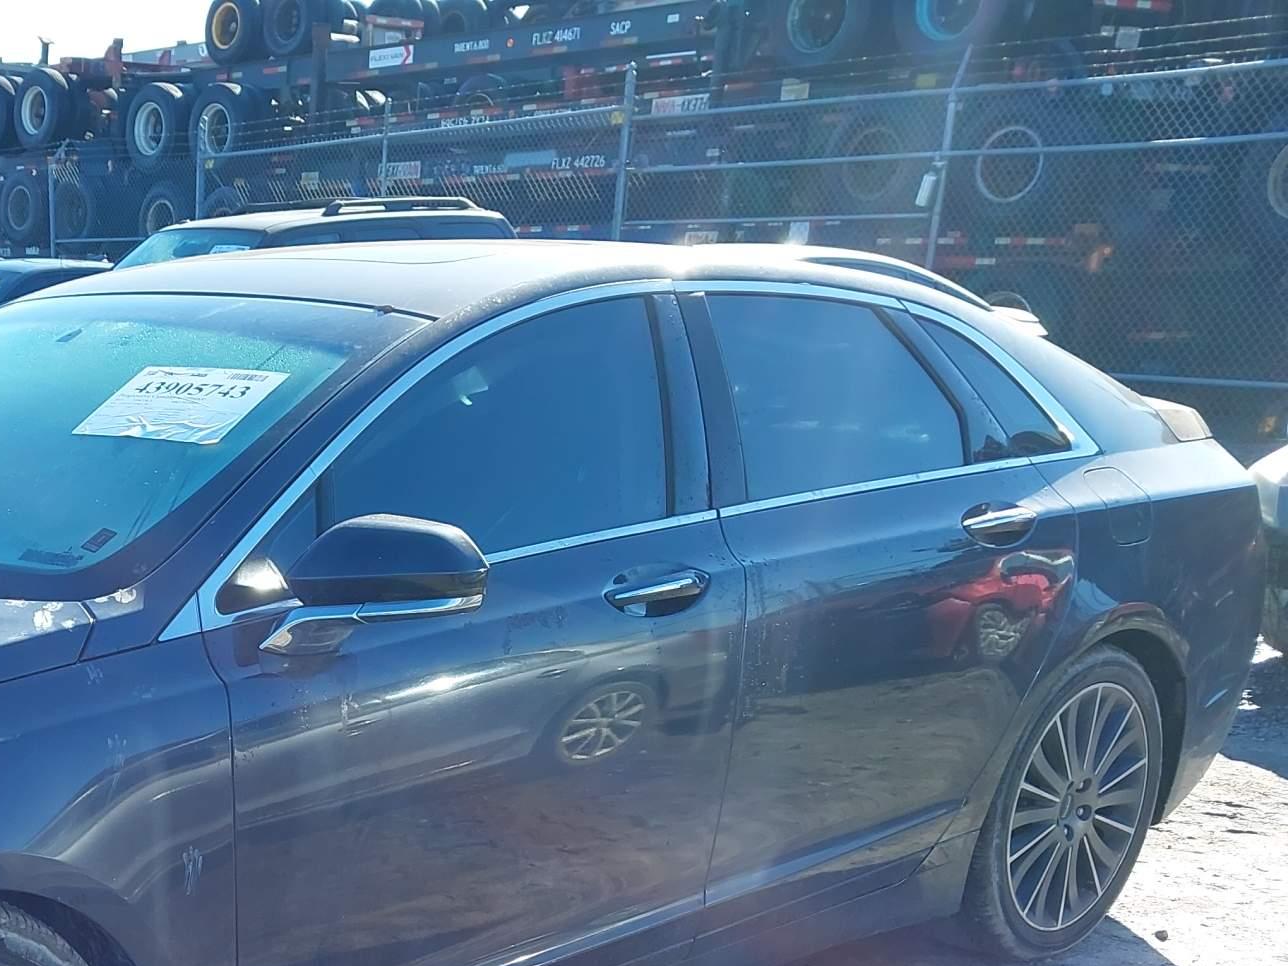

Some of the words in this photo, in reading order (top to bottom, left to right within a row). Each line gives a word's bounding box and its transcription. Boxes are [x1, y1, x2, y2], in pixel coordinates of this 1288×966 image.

[609, 20, 632, 35] SACP
[551, 157, 572, 170] FLXZ
[574, 154, 606, 169] 442726
[135, 381, 252, 399] 43905743
